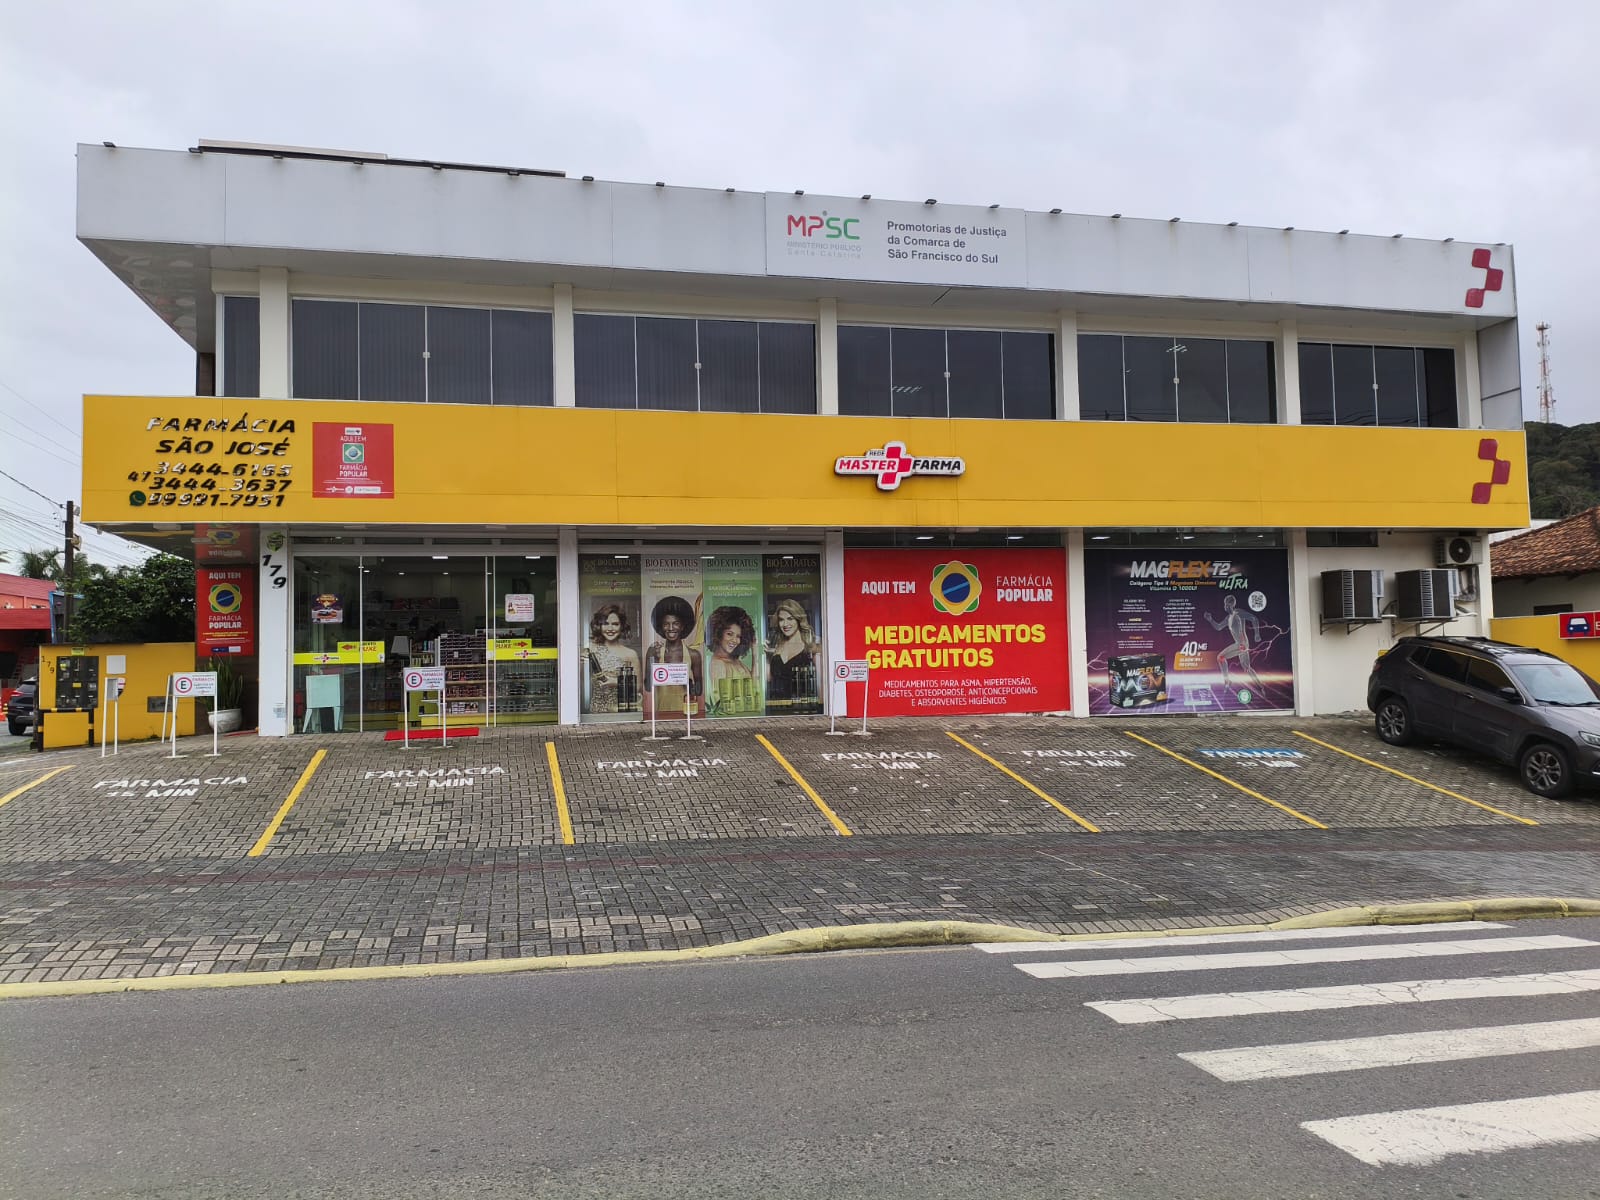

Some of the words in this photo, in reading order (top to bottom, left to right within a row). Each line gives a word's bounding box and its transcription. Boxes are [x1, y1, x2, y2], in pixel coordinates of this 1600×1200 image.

[787, 214, 860, 240] MPSC
[887, 220, 951, 234] Promotorias
[954, 224, 967, 235] de
[969, 225, 1007, 238] Justiça
[887, 235, 900, 246] da
[902, 236, 950, 248] Comarca
[953, 239, 966, 248] de
[887, 248, 908, 259] São
[911, 249, 962, 262] Francisco
[965, 252, 979, 263] do
[981, 253, 999, 264] Sul
[146, 412, 296, 433] FARMÁCIA
[155, 436, 214, 454] SÃO
[224, 436, 291, 456] JOSÉ
[839, 459, 897, 470] MASTER
[912, 459, 961, 470] FARMA
[1130, 560, 1212, 579] MAGFLEX
[1212, 561, 1232, 577] T2
[208, 572, 226, 580] AQUI
[227, 572, 242, 580] TEM
[996, 575, 1053, 587] FARMÁCIA
[861, 581, 890, 595] AQUI
[893, 581, 916, 594] TEM
[996, 588, 1054, 602] POPULAR
[864, 624, 1046, 645] MEDICAMENTOS
[1180, 641, 1198, 657] 40
[865, 648, 994, 670] GRATUITOS
[658, 670, 664, 679] E
[840, 667, 846, 675] E
[180, 680, 187, 690] E
[411, 675, 417, 685] E
[884, 680, 939, 688] MEDICAMENTOS
[940, 680, 959, 688] PARA
[961, 679, 982, 688] ASMA,
[984, 676, 1032, 686] HIPERTENSÃO,
[879, 689, 914, 698] DIABETES,
[914, 688, 967, 697] OSTEOPOROSE,
[968, 686, 1038, 696] ANTICONCEPCIONAIS
[911, 699, 917, 707] E
[917, 698, 968, 707] ABSORVENTES
[968, 696, 1008, 705] HIGIÊNICOS
[821, 751, 942, 761] FARMACIA
[597, 758, 728, 769] FARMACIA
[879, 761, 921, 770] MIN
[364, 766, 506, 780] FARMACIA
[656, 768, 699, 778] MIN
[92, 776, 248, 789] FARMACIA
[428, 777, 474, 788] MIN
[145, 788, 199, 798] MIN
